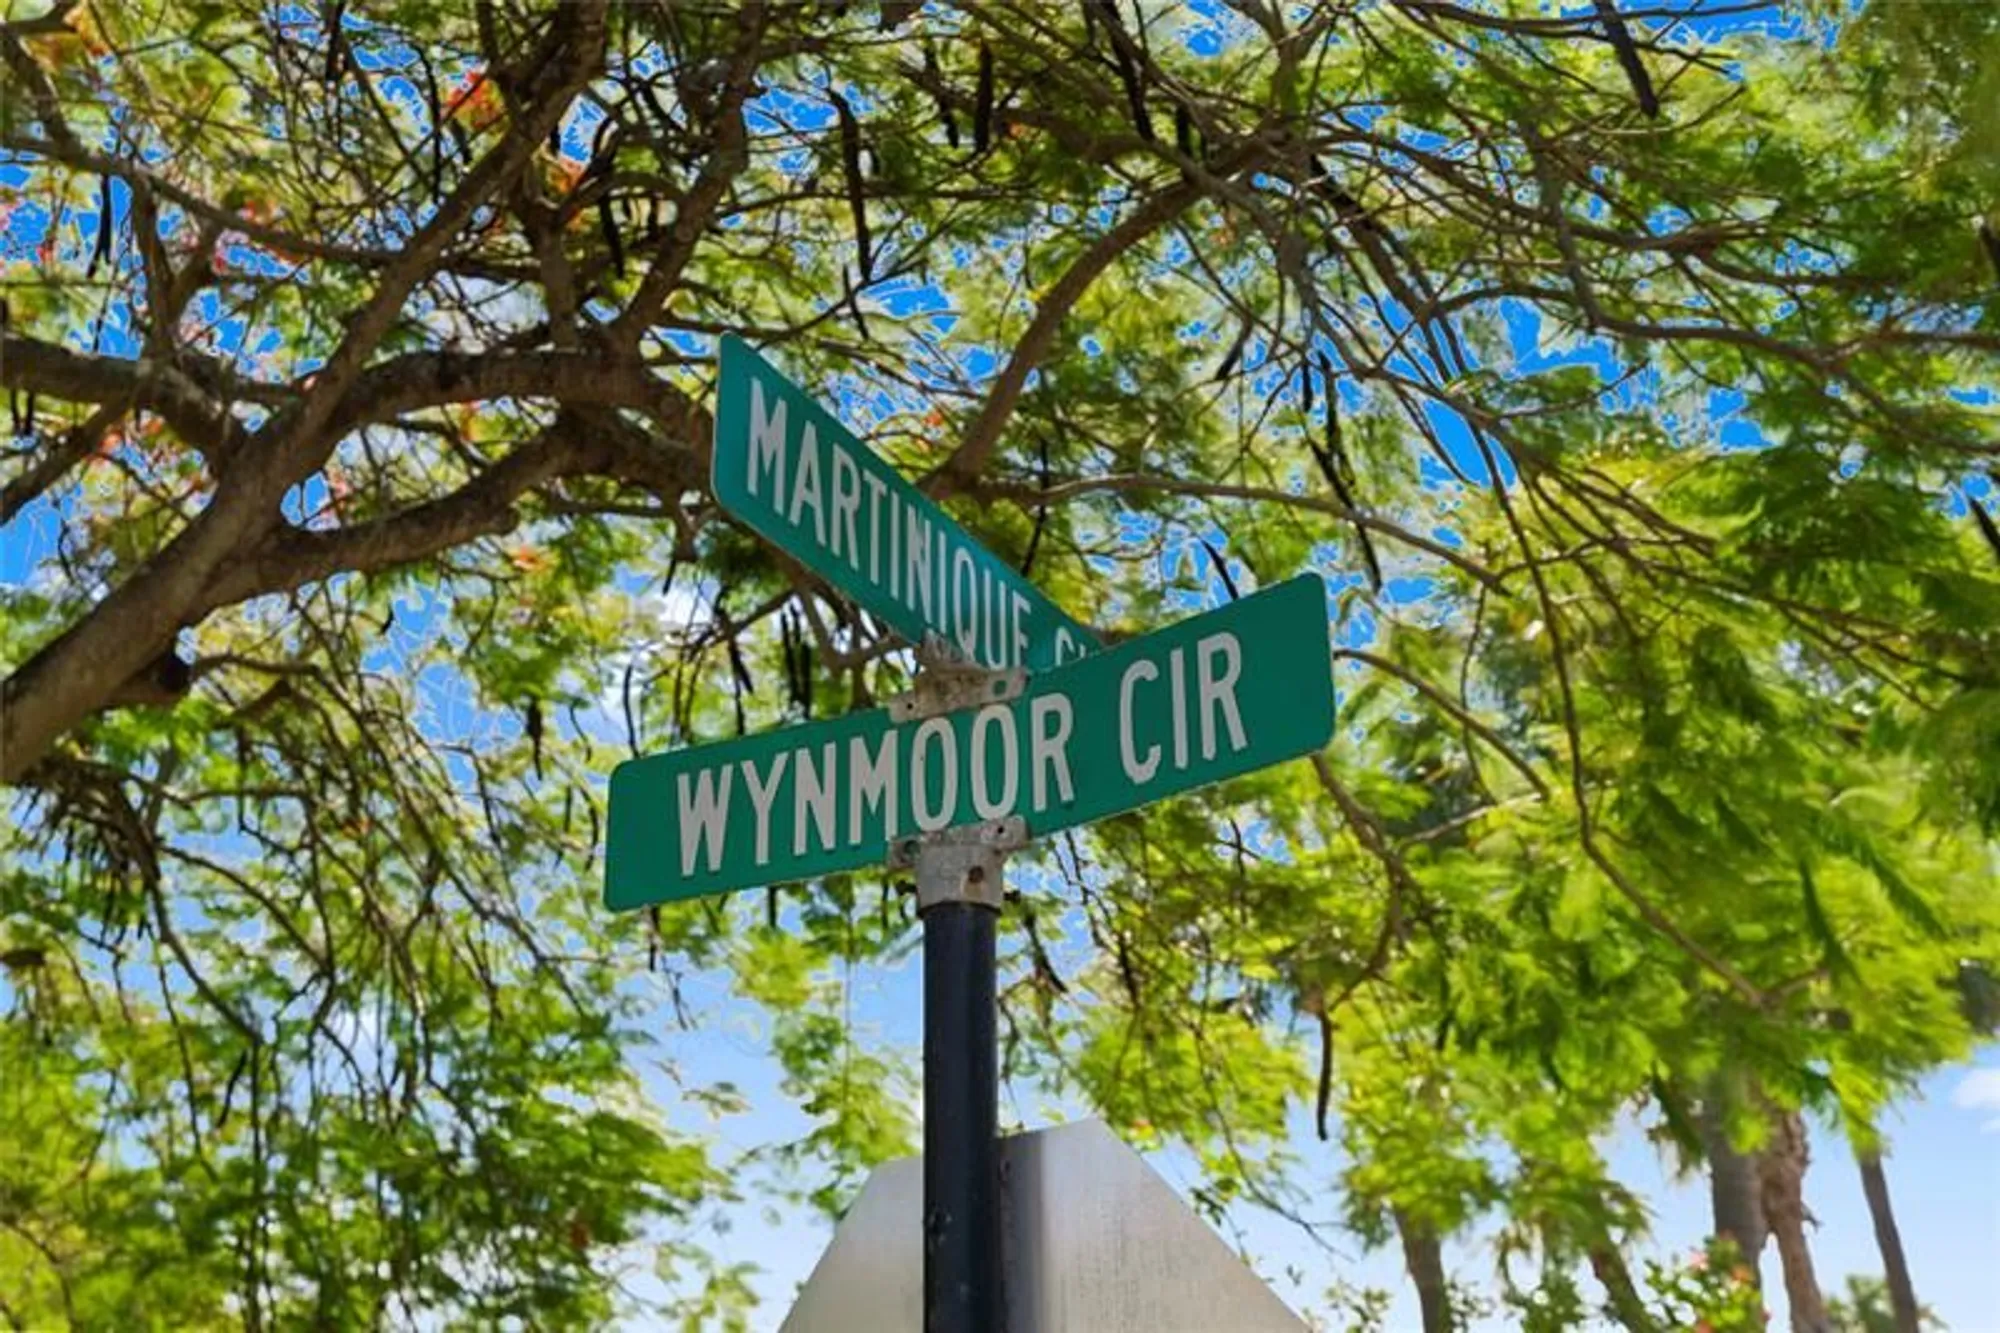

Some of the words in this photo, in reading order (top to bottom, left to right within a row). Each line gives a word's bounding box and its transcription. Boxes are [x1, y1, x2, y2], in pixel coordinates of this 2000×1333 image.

[747, 377, 1031, 669] MARTINIQUE
[678, 692, 1074, 876] WYNMOOR
[1119, 632, 1249, 784] CIR
